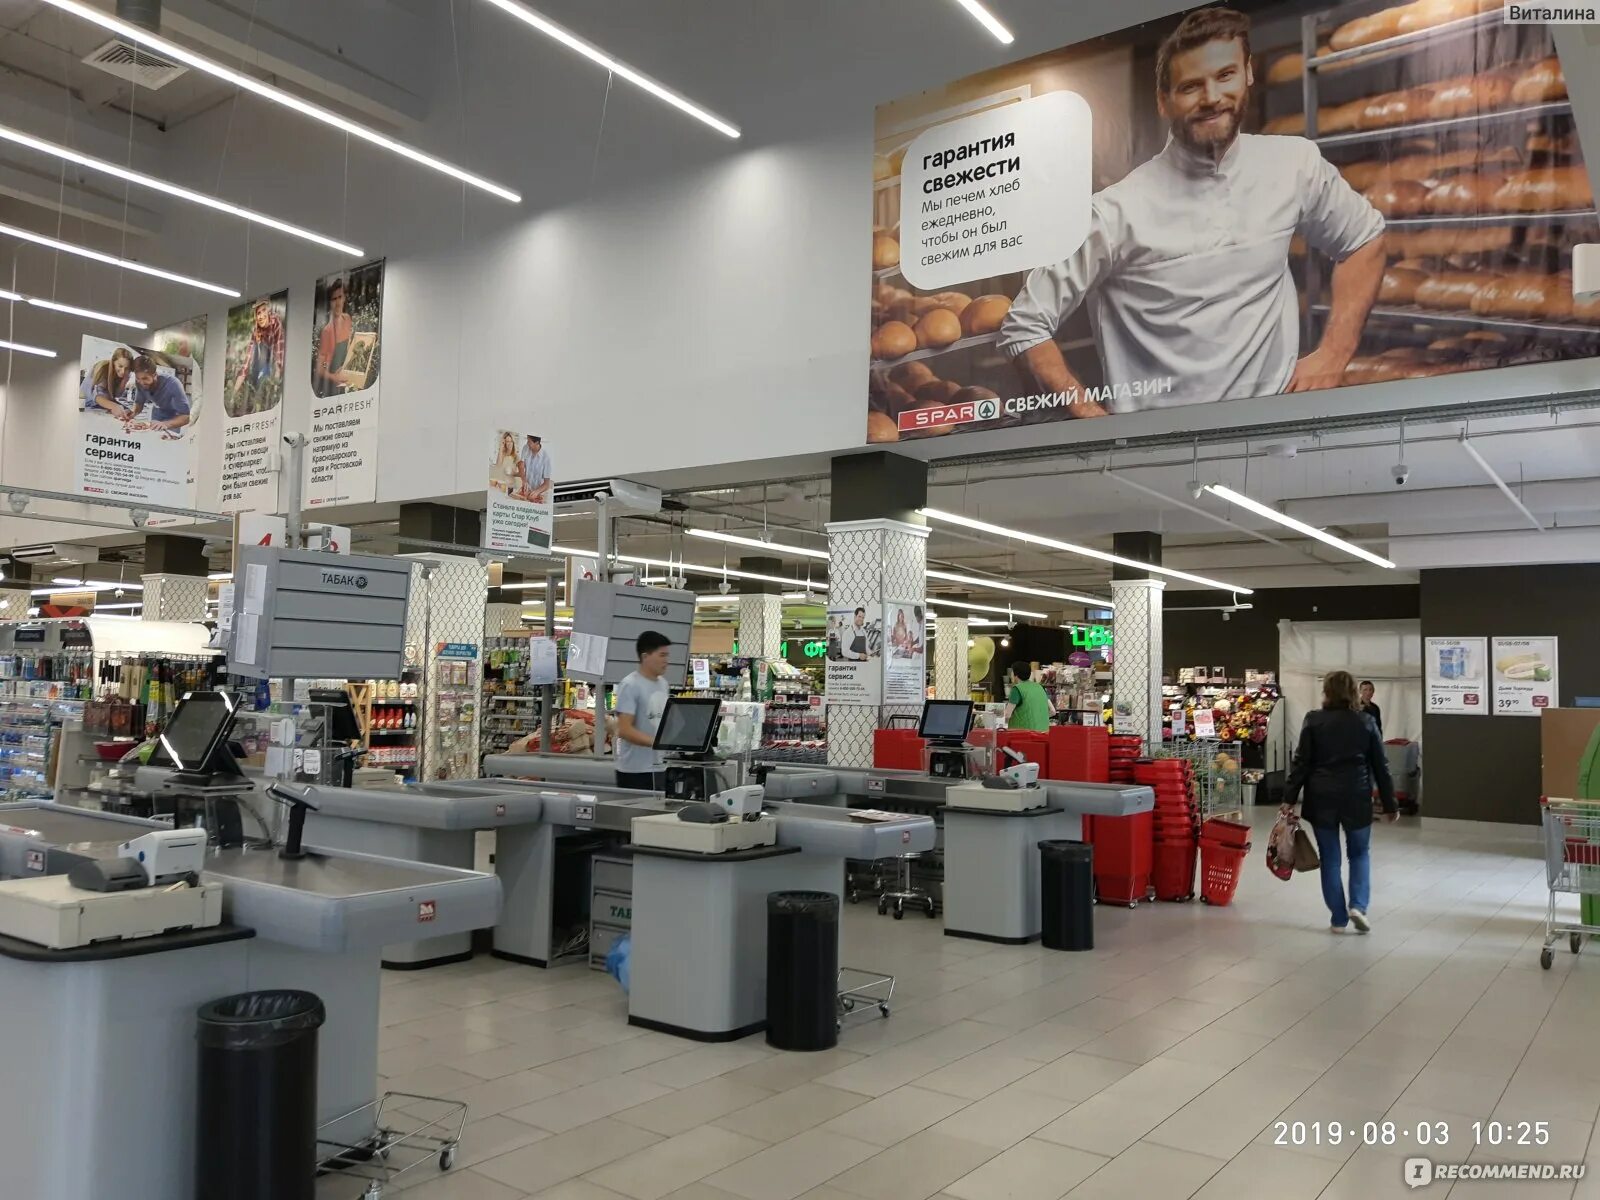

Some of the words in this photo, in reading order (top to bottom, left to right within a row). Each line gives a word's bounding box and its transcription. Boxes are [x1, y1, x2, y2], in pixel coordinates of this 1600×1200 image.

[922, 132, 1015, 171] гарантия
[922, 155, 1021, 195] свежести
[921, 199, 942, 214] Мы
[945, 188, 985, 208] печем
[988, 178, 1021, 198] хлеб
[920, 206, 997, 232] ежедневно,
[921, 230, 959, 249] чтобы
[961, 225, 978, 239] он
[981, 219, 1008, 235] был
[921, 248, 971, 267] свежим
[973, 241, 998, 259] для
[1000, 233, 1023, 248] вас
[1004, 386, 1079, 414] СВЕЖИЙ
[1083, 377, 1173, 404] МАГАЗИН
[915, 403, 974, 426] SPAR
[313, 424, 324, 433] Мы
[324, 419, 361, 431] поставляем
[85, 433, 142, 450] гарантия
[334, 431, 354, 440] овощи
[85, 447, 135, 462] сервиса
[312, 450, 357, 463] Краснодарского
[311, 465, 325, 474] края
[330, 459, 363, 470] Ростовской
[311, 474, 334, 483] области
[511, 512, 526, 520] Спар
[321, 573, 354, 586] ТАБАК
[640, 603, 660, 614] ТАБАК
